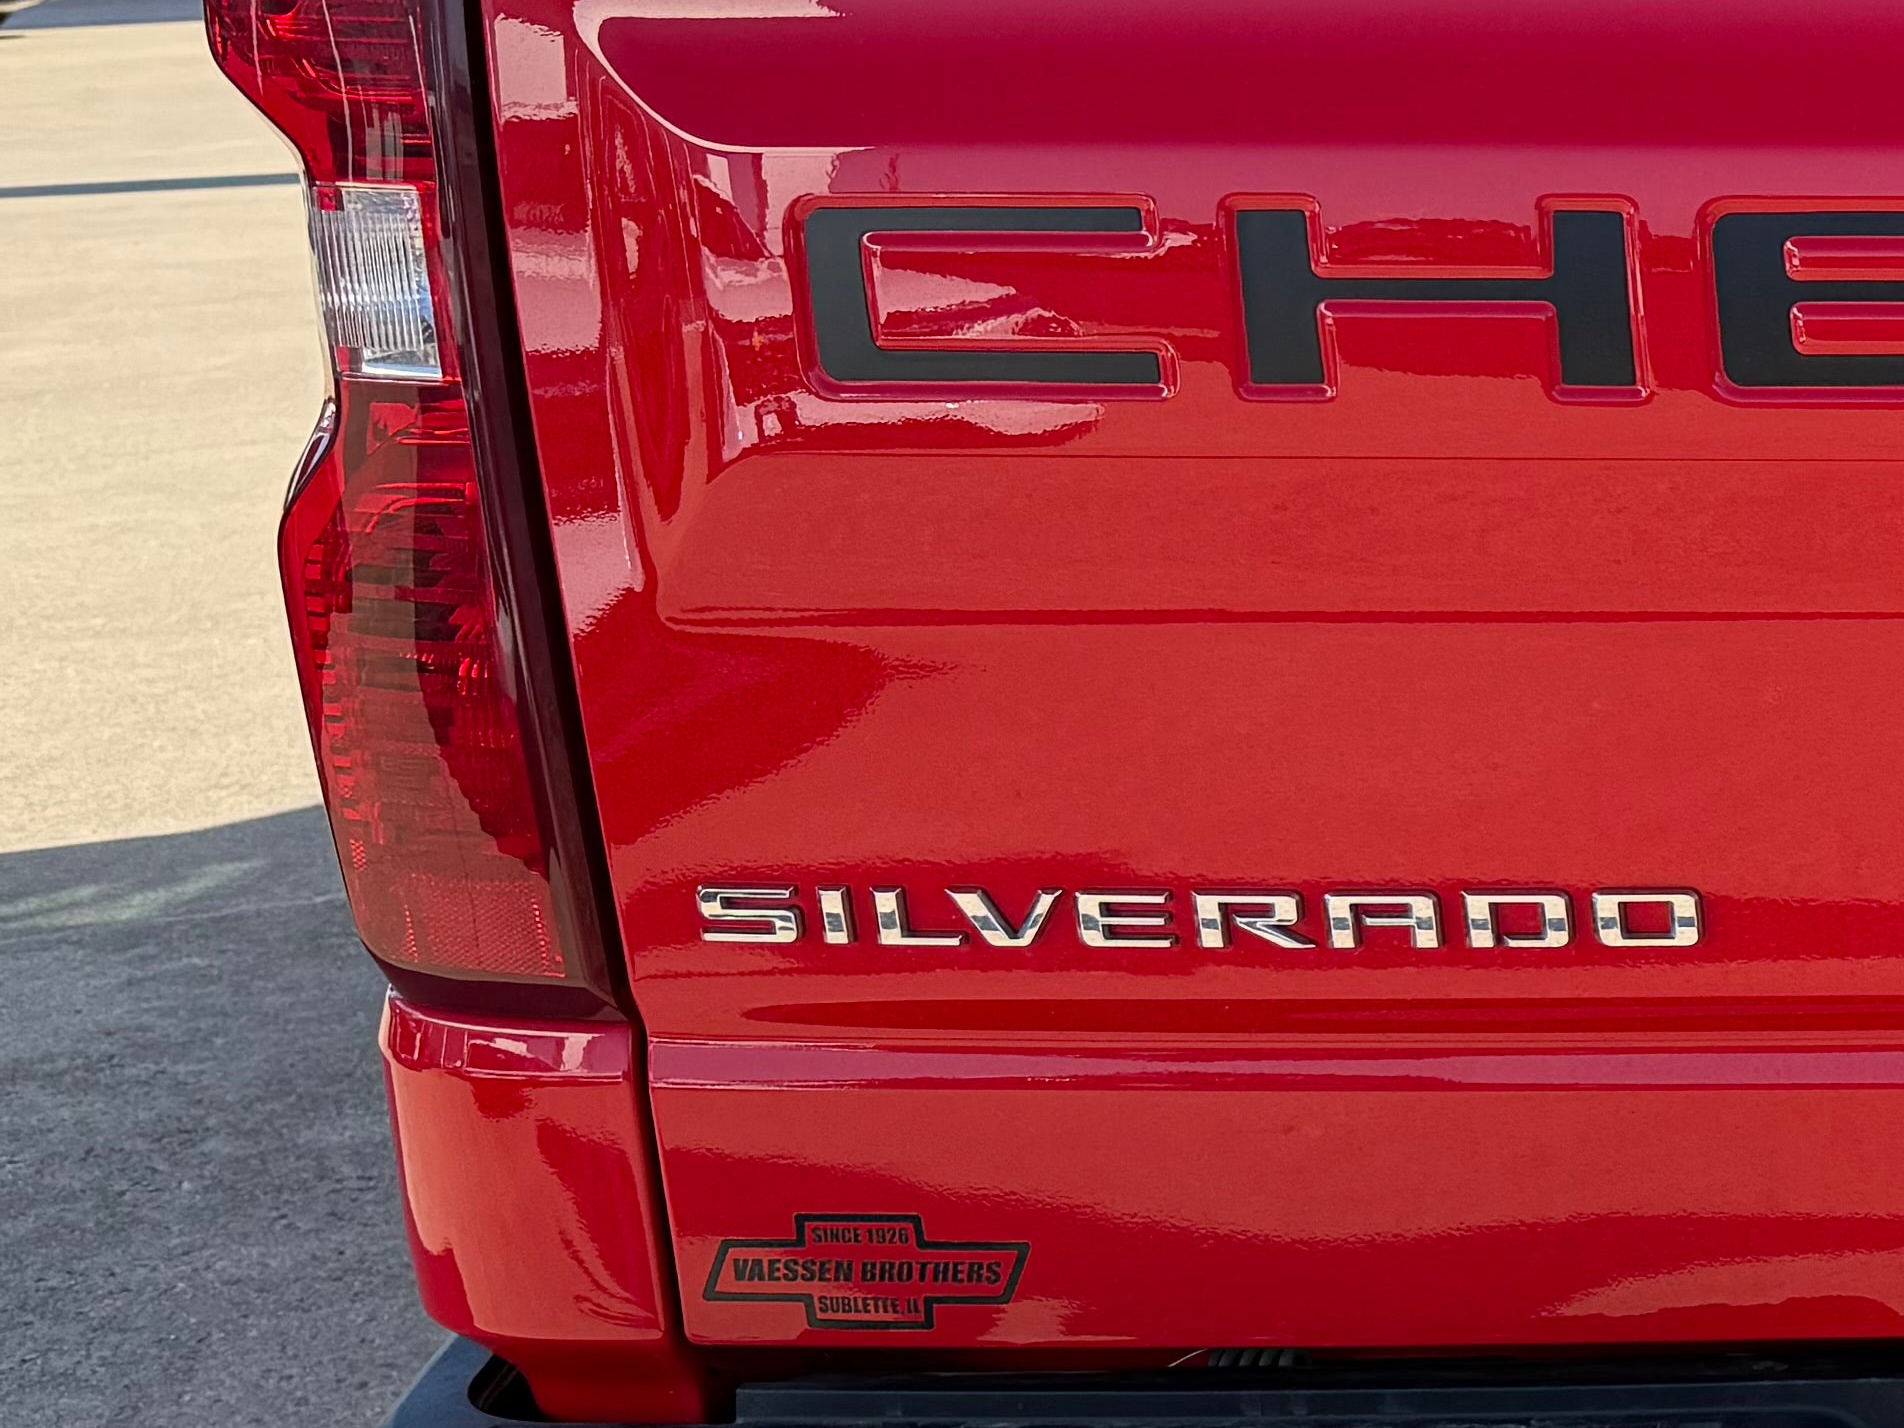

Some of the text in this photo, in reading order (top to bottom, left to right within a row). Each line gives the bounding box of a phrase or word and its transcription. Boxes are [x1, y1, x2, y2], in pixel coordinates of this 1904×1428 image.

[695, 883, 1708, 950] SILVERADO
[812, 1227, 861, 1243] SINCE
[732, 1258, 1003, 1284] VAESSEN BROTHERS
[905, 1297, 920, 1314] IL
